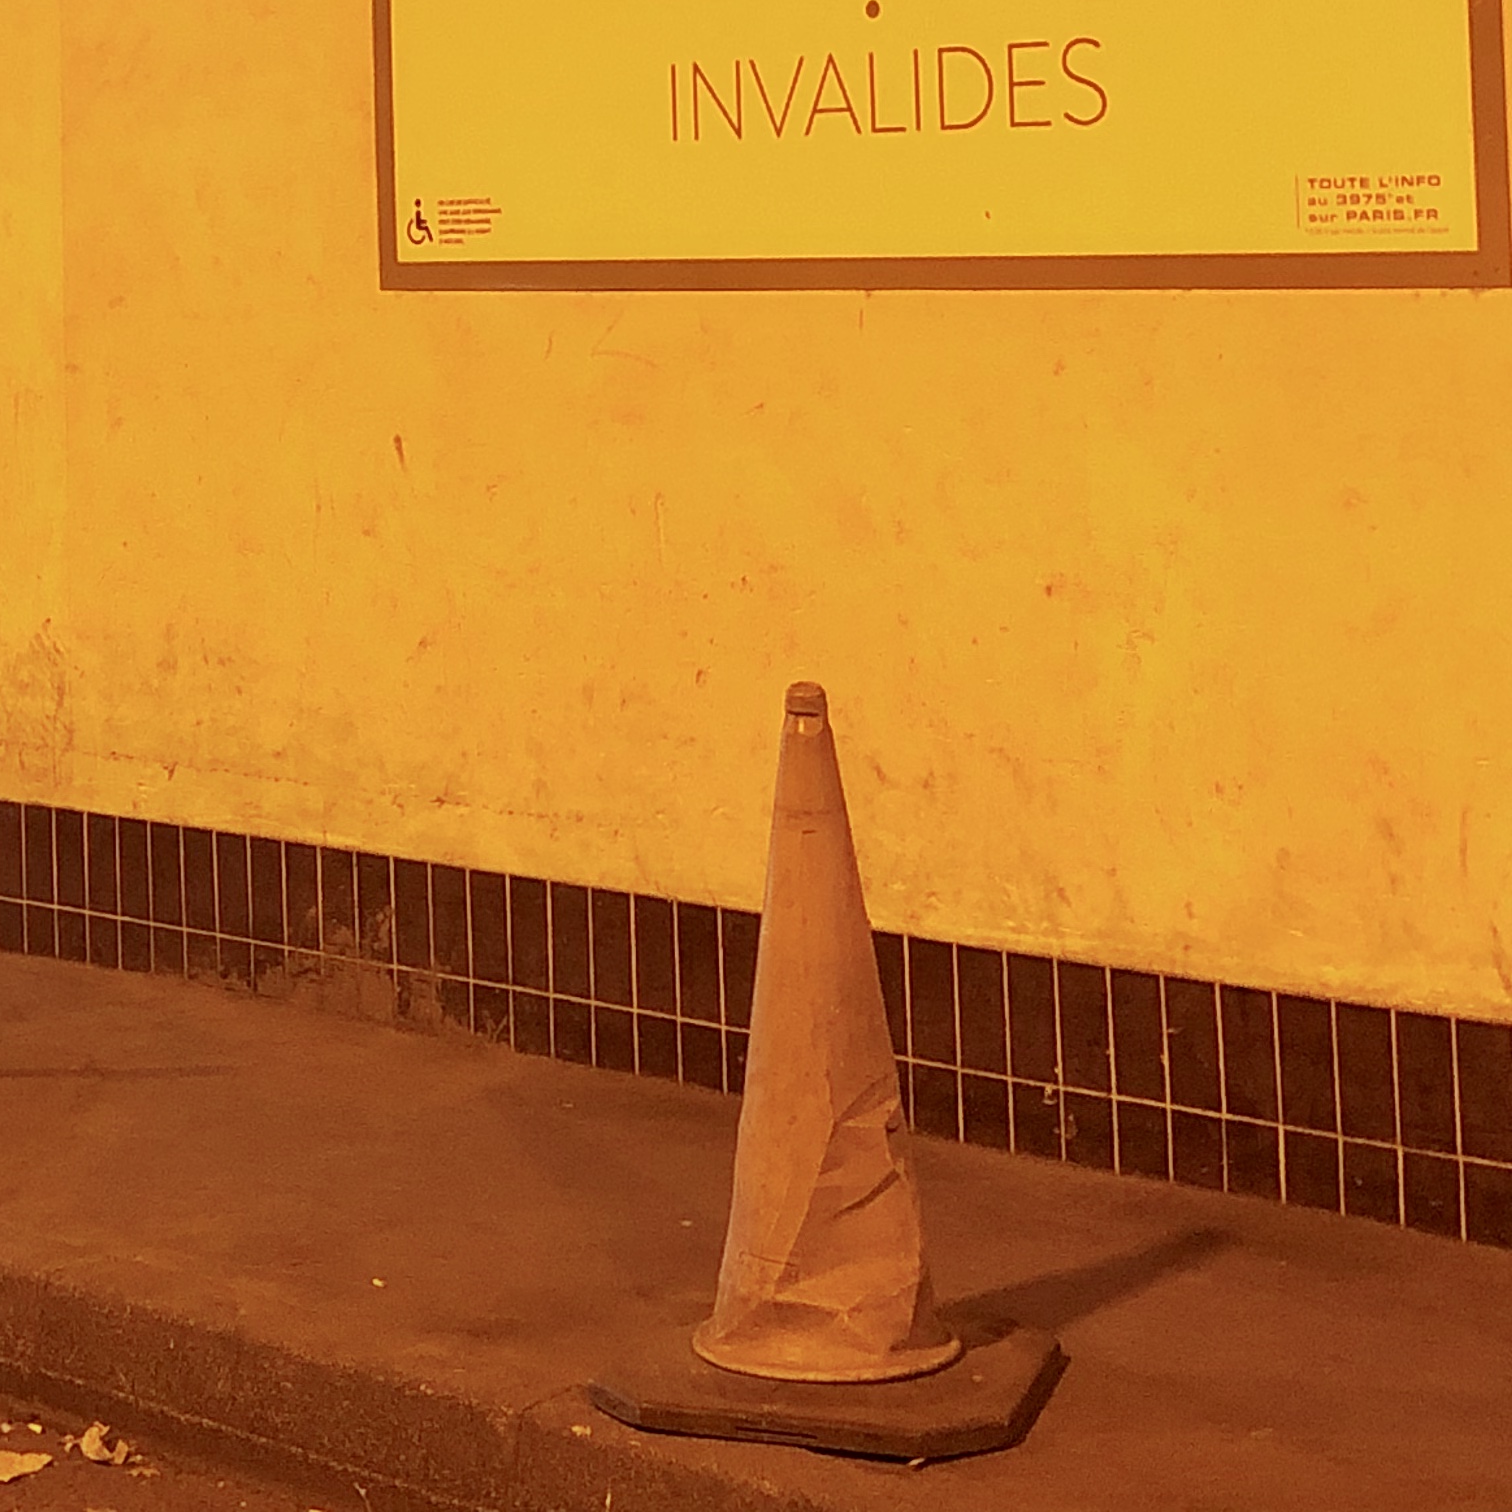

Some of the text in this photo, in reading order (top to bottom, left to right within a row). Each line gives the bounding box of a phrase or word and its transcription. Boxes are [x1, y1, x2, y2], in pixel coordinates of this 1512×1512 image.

[670, 37, 1108, 142] INVALIDES
[1307, 174, 1442, 189] TOUTE L'INFO
[1307, 196, 1328, 206] au
[1396, 194, 1414, 205] et
[1308, 208, 1439, 223] sur PARIS.FR
